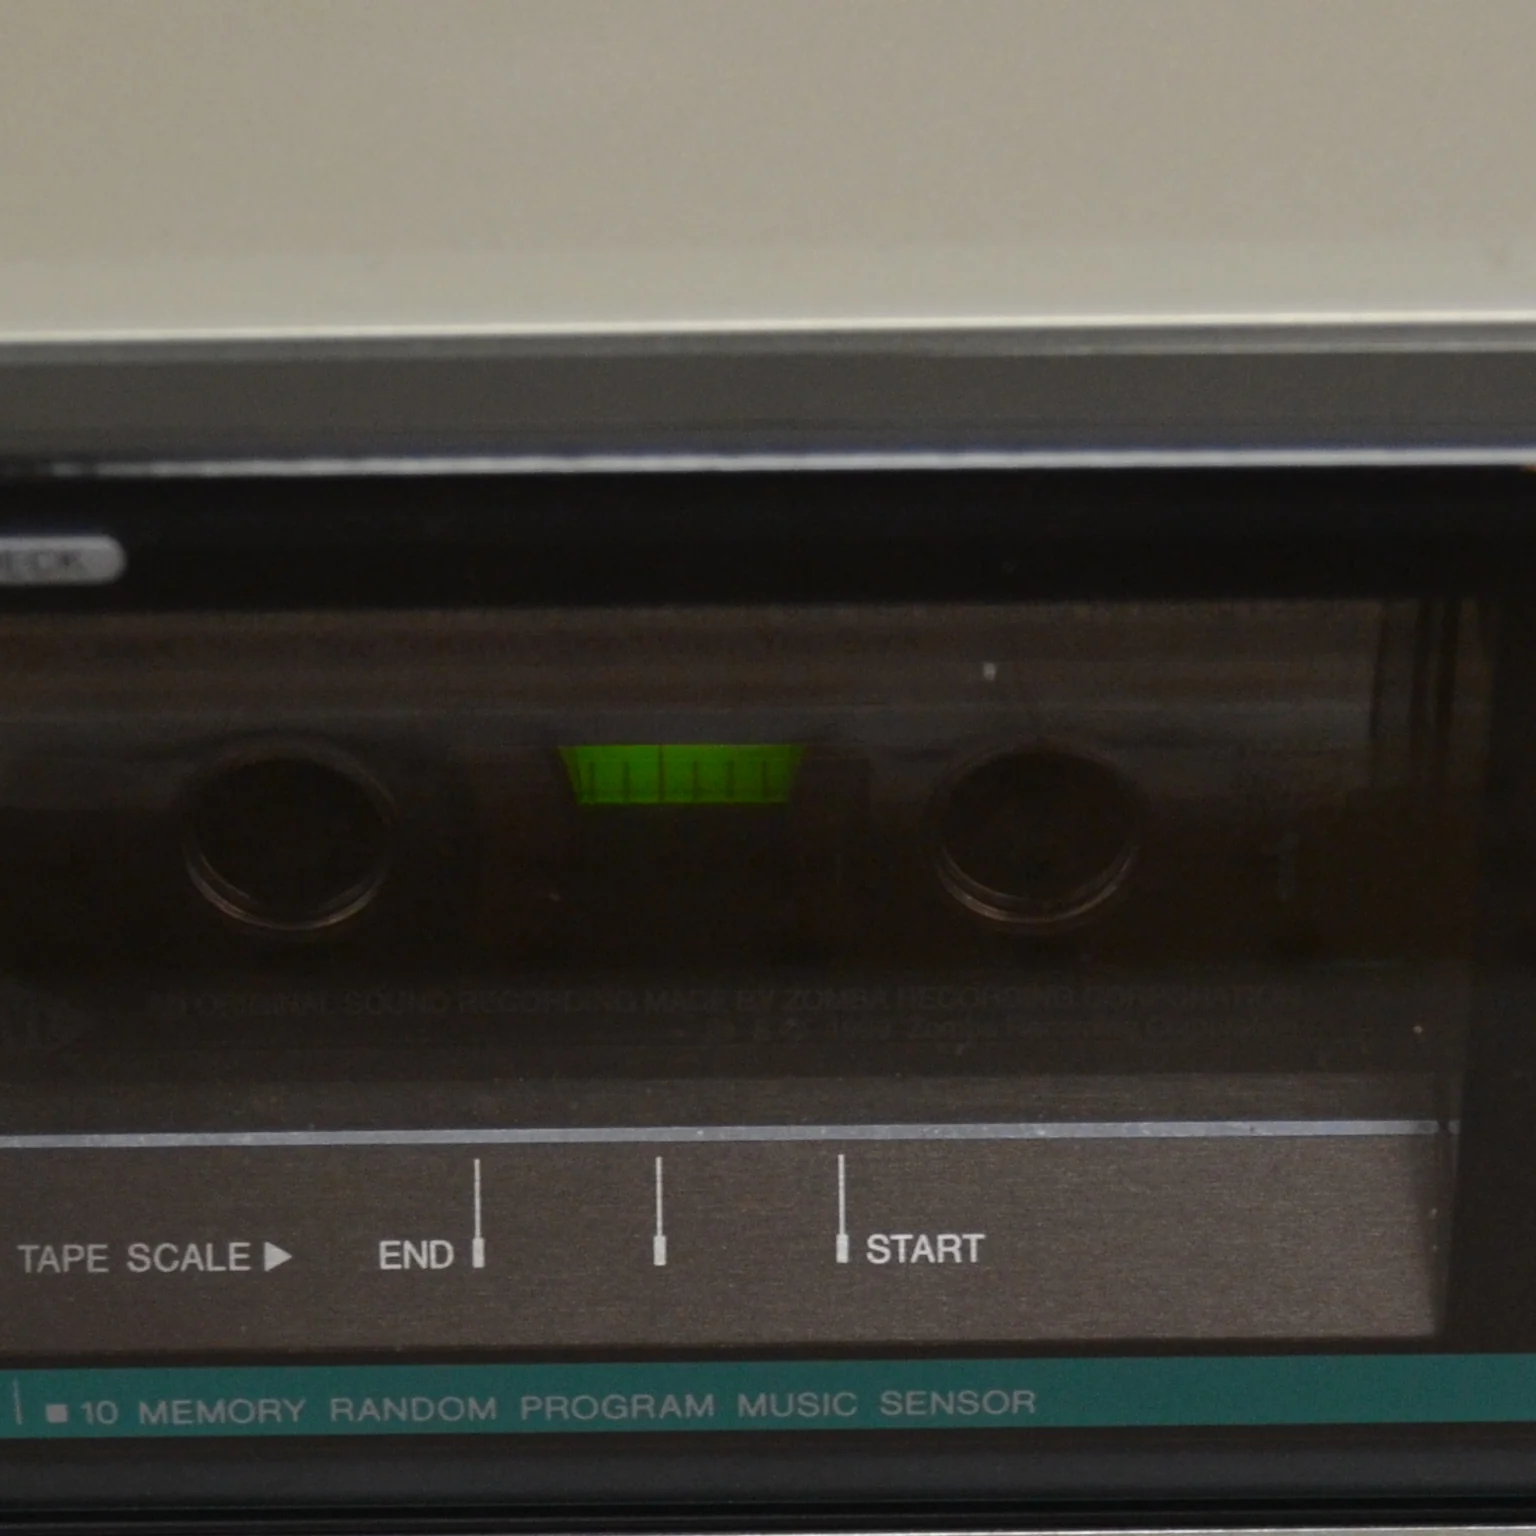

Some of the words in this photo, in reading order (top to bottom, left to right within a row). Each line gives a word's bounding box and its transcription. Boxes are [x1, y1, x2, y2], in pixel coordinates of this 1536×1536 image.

[17, 1243, 109, 1273] TAPE
[126, 1241, 251, 1273] SCALE
[379, 1239, 455, 1270] END
[866, 1233, 986, 1265] START
[80, 1399, 119, 1425] 10
[138, 1397, 306, 1426] MEMORY
[329, 1395, 497, 1422] RANDOM
[520, 1393, 715, 1421] PROGRAM
[737, 1391, 858, 1418] MUSIC
[880, 1389, 1036, 1417] SENSOR
